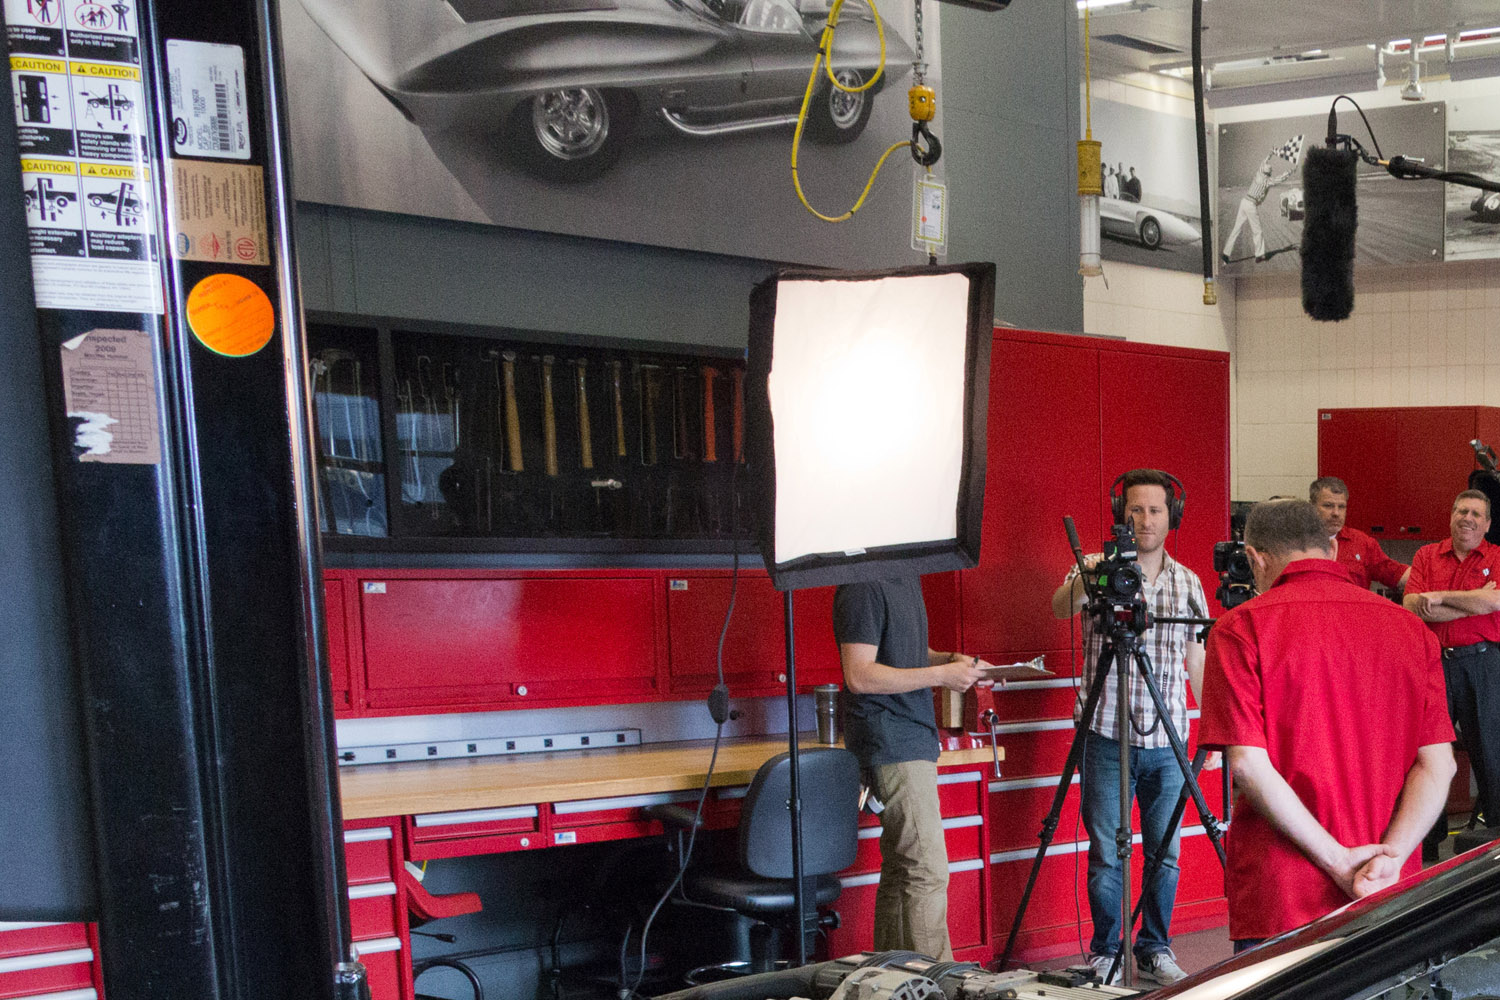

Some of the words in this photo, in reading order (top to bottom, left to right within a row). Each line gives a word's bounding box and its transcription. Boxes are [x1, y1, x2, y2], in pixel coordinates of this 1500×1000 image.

[70, 32, 103, 40] Authorized
[15, 61, 60, 72] CAUTION
[90, 66, 136, 78] CAUTION
[27, 161, 71, 172] CAUTION
